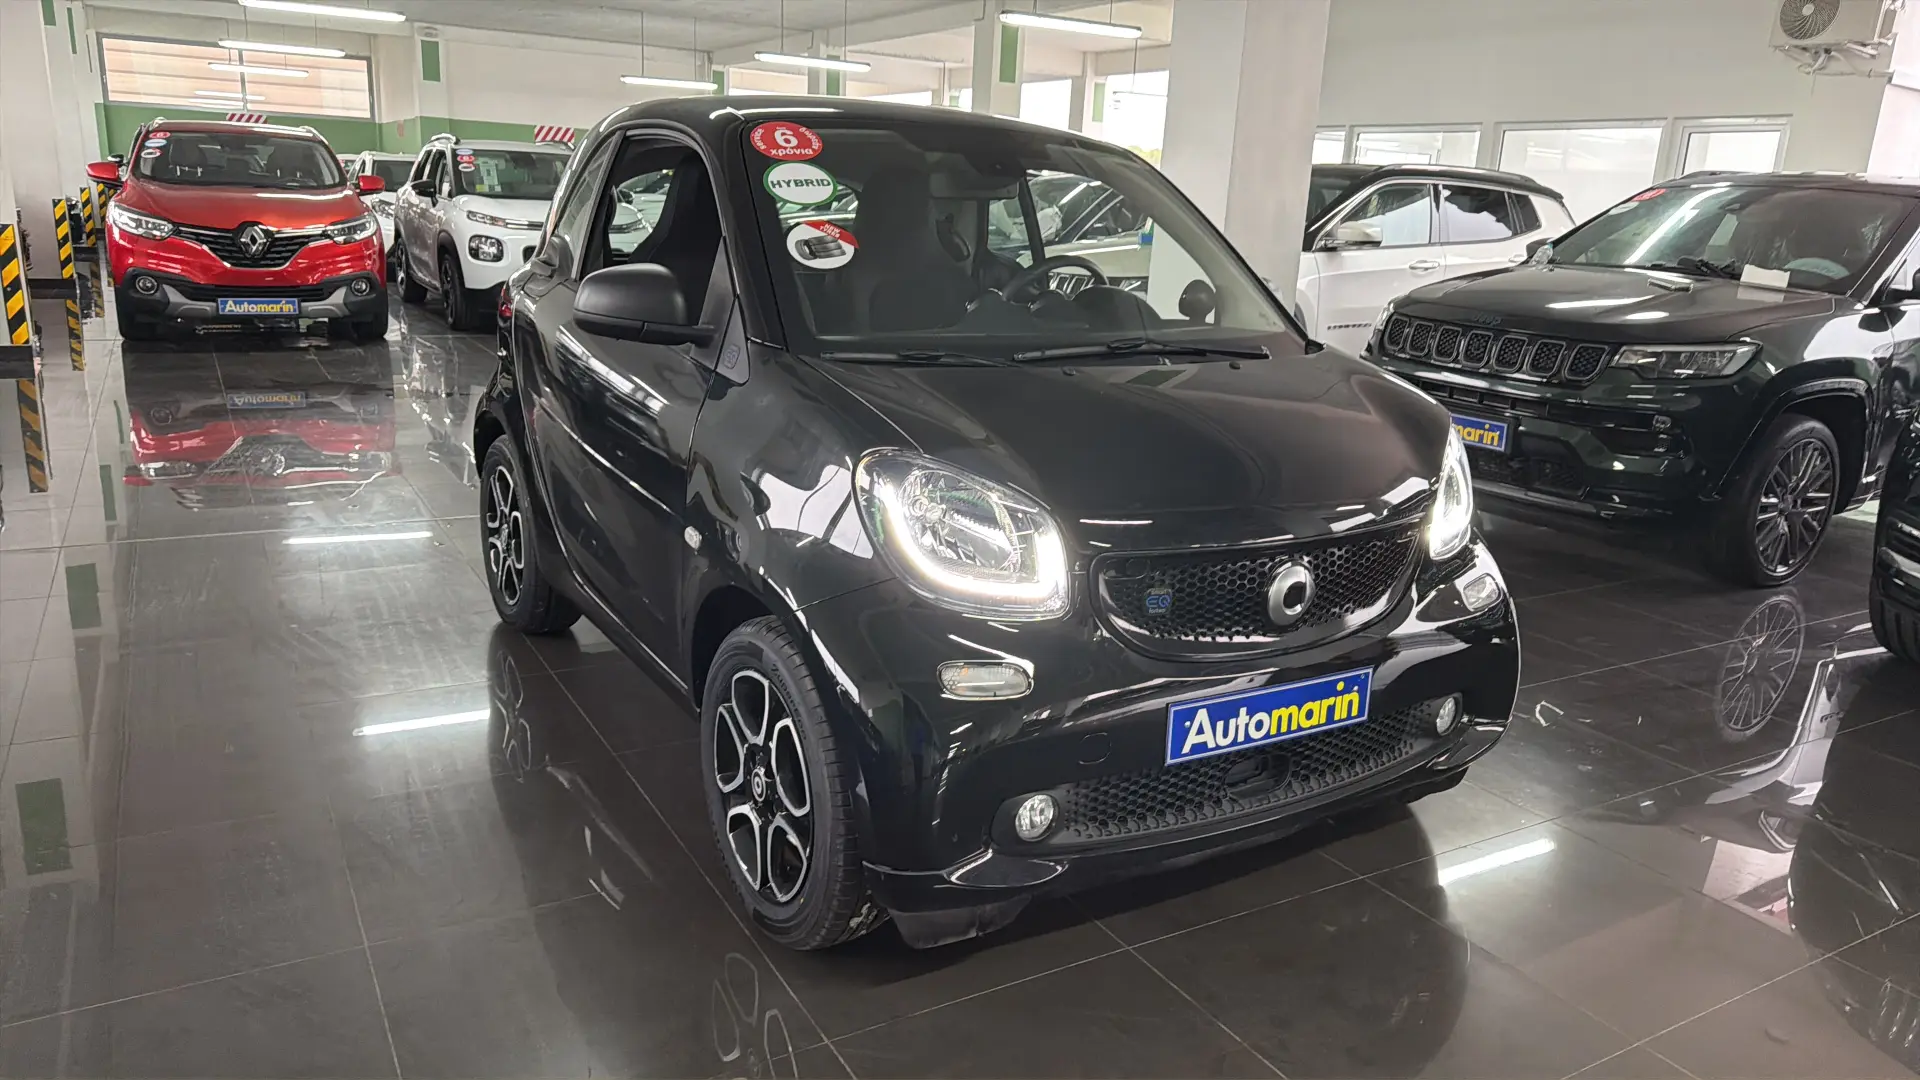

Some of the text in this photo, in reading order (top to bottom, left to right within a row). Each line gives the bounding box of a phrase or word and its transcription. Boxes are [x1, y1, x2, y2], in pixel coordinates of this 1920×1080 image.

[774, 129, 799, 147] 6
[770, 147, 813, 156] χρόνια
[770, 178, 832, 189] HYBRID
[225, 300, 293, 313] Automarin
[1145, 594, 1171, 608] EQ
[1181, 681, 1360, 755] Automarin
